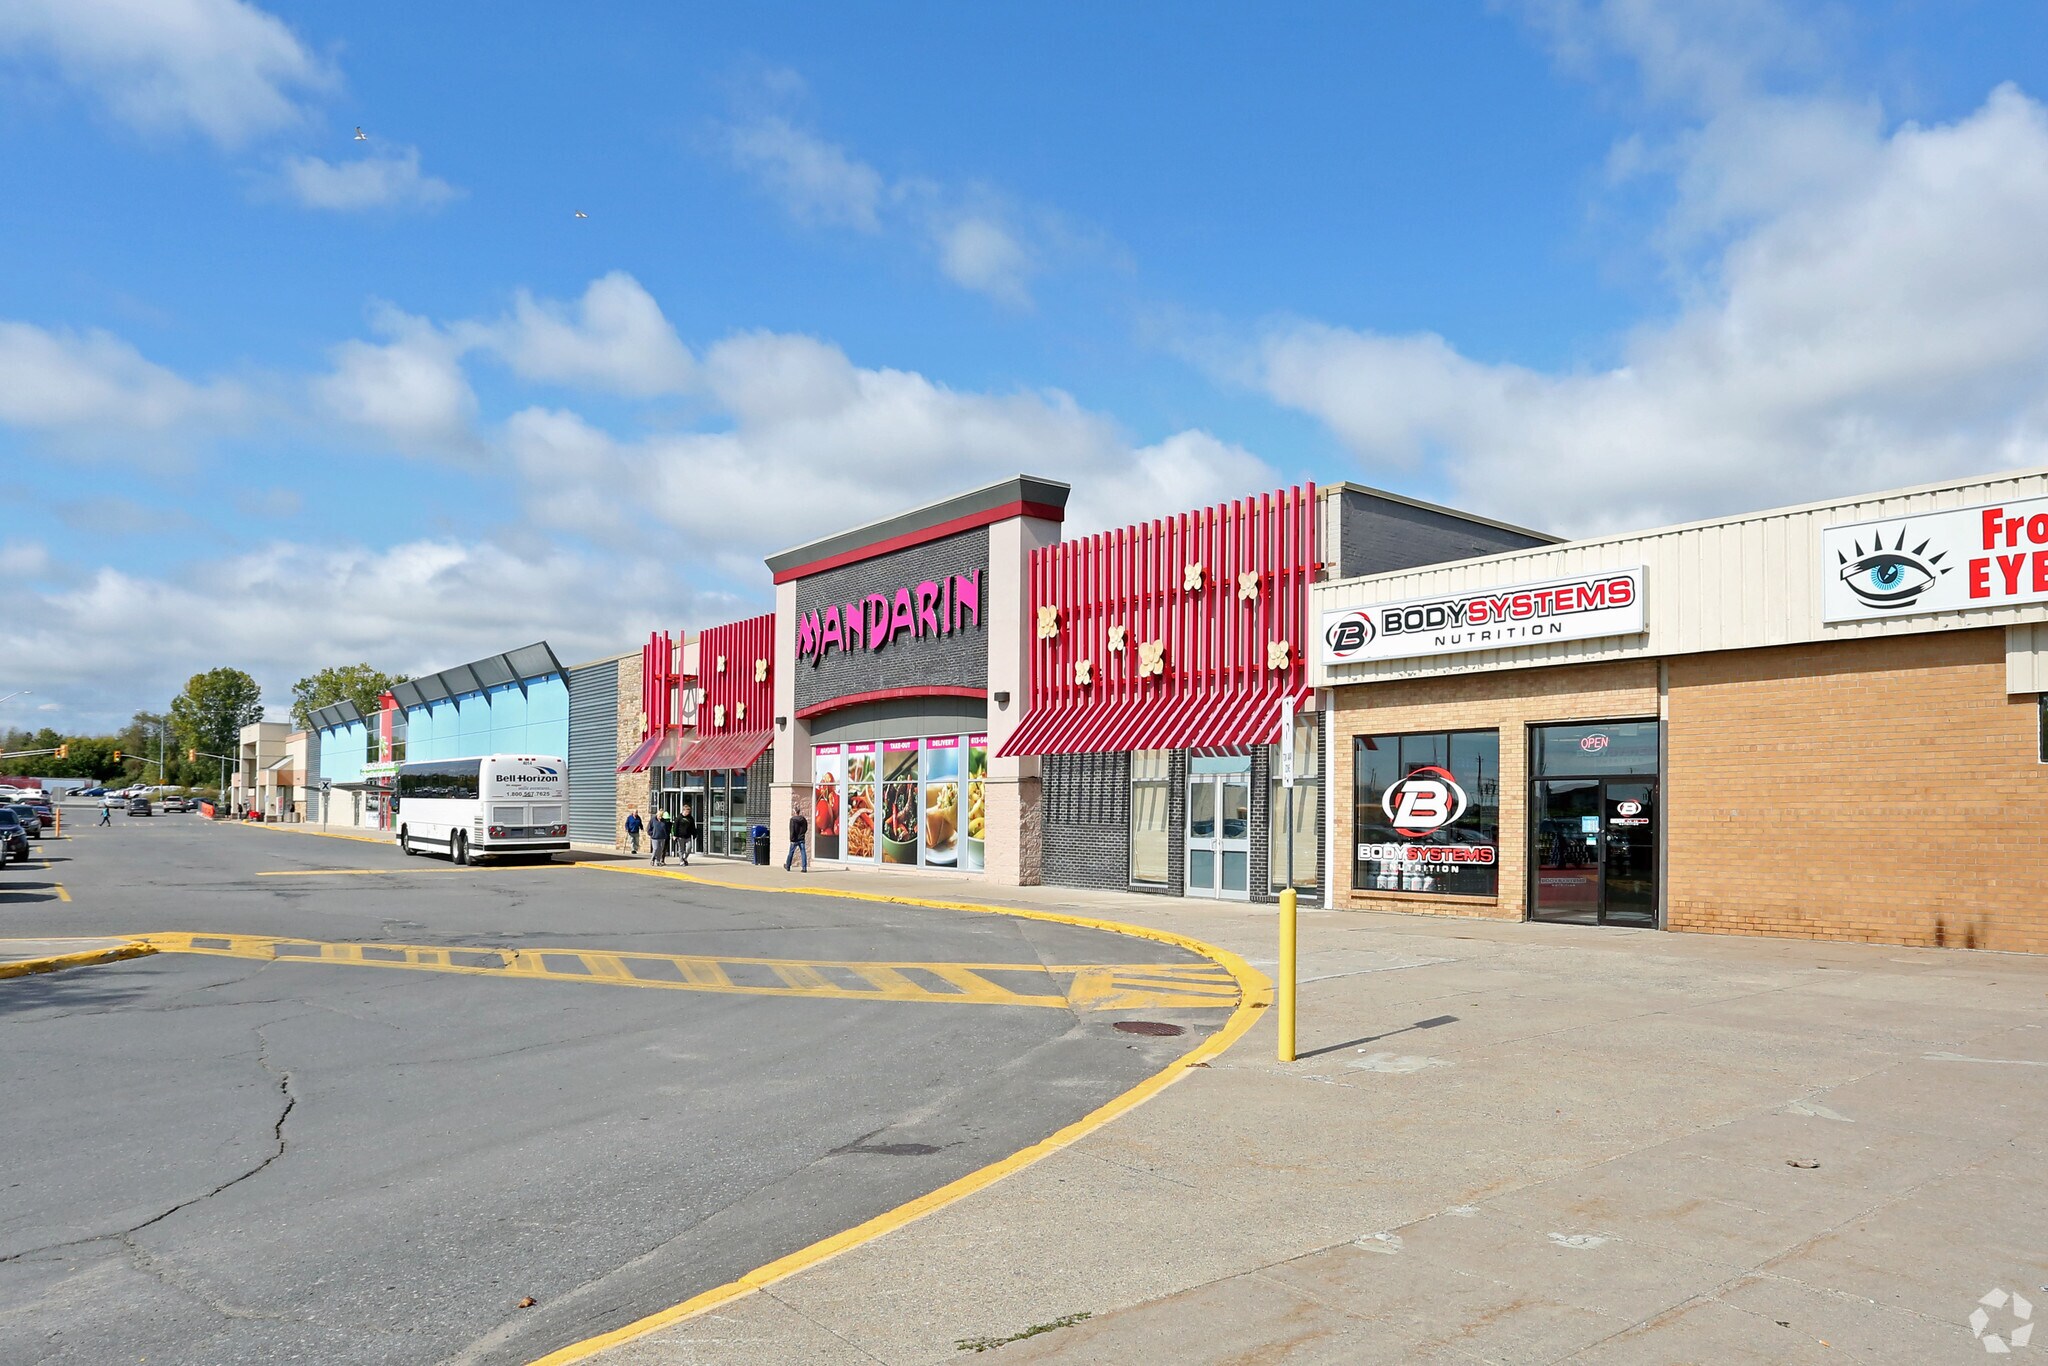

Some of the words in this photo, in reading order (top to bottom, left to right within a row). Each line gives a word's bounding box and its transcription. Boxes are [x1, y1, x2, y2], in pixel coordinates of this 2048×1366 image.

[1982, 508, 2048, 550] Fro
[1969, 550, 2048, 599] EYE
[1382, 576, 1635, 636] BODYSYSTEMS
[796, 568, 980, 668] MANDARIN
[1435, 622, 1562, 646] NUTRITION
[931, 739, 955, 747] DELIVERY
[1581, 736, 1609, 750] OPEN
[496, 774, 515, 782] Bell
[517, 774, 558, 782] Horizon
[1358, 844, 1495, 864] BODYSYSTEMS
[1389, 864, 1459, 873] NUTRITION
